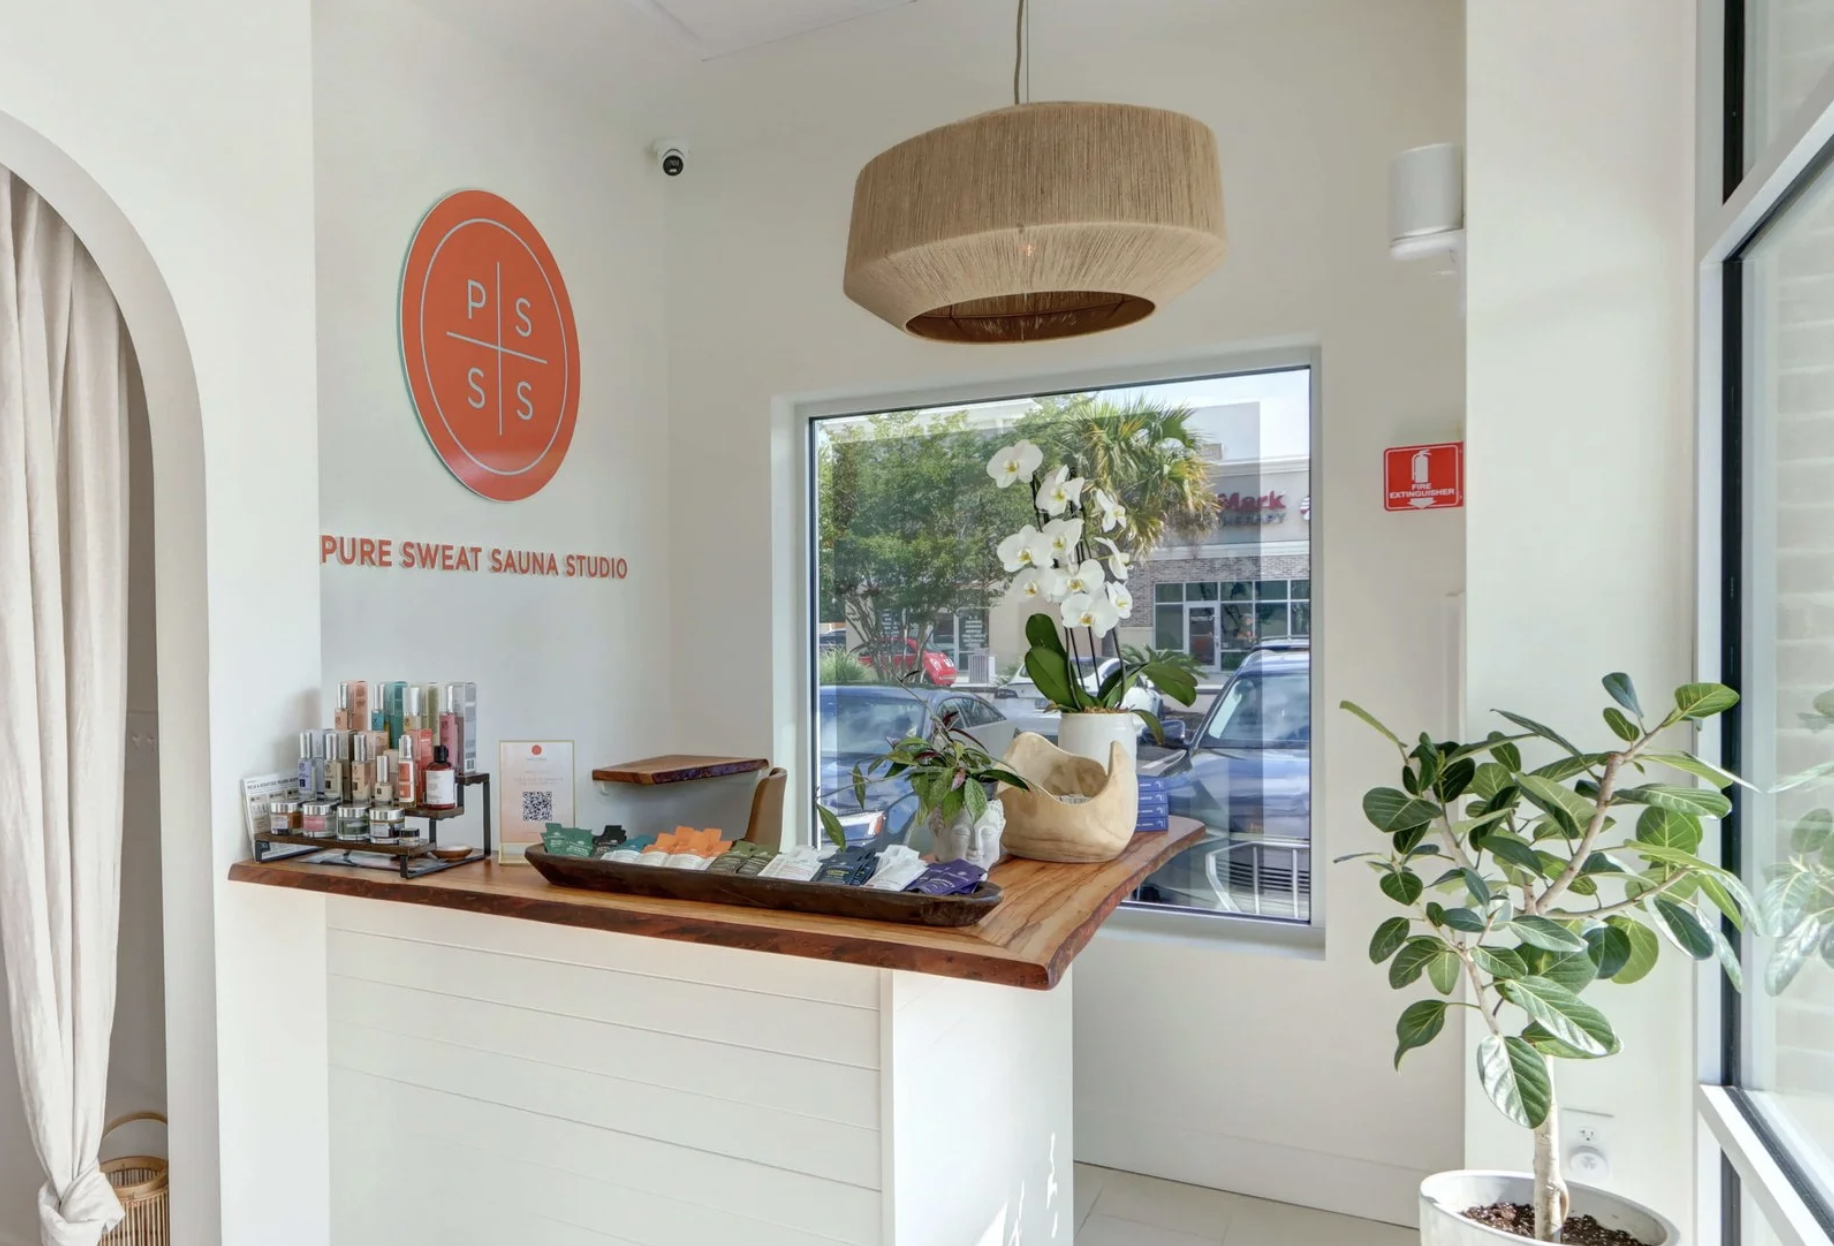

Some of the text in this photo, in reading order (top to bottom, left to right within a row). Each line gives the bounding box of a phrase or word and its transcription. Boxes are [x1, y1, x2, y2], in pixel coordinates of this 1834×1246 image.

[467, 279, 532, 337] P S
[467, 367, 533, 421] S S
[1389, 488, 1455, 499] EXTINGUISHER
[1411, 482, 1432, 491] FIRE
[1220, 512, 1286, 527] HERAPY
[320, 535, 628, 580] PURE SWEAT SAUNA STUDIO
